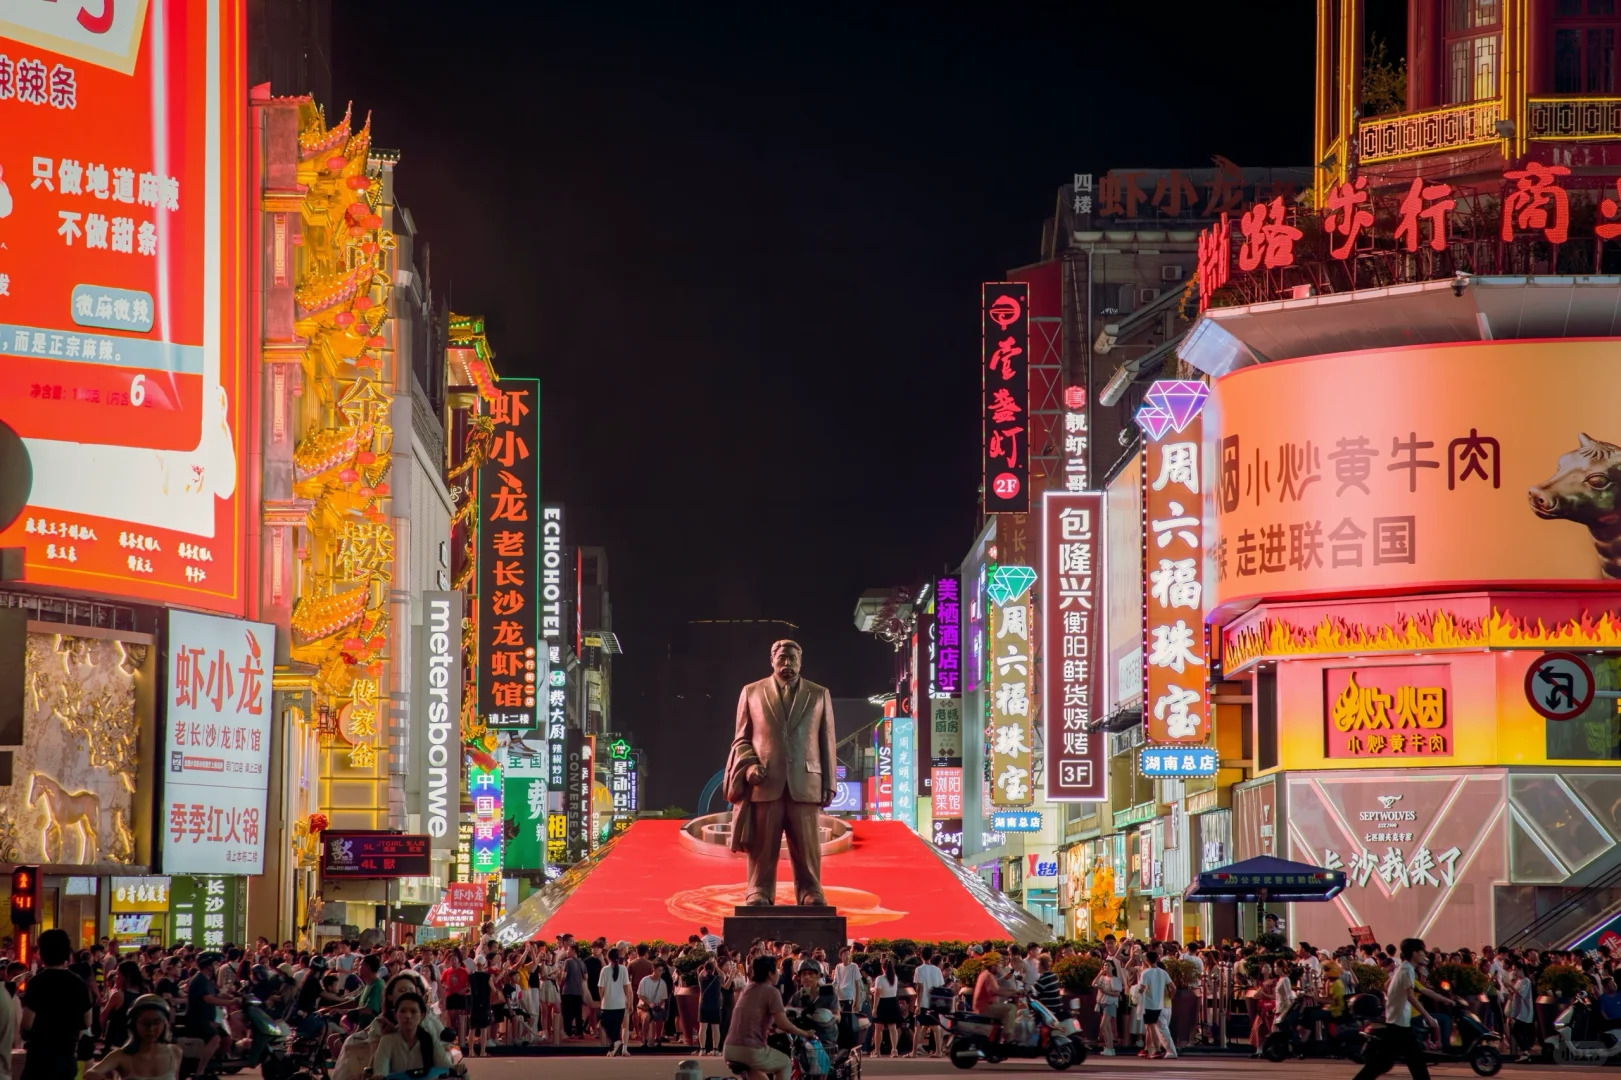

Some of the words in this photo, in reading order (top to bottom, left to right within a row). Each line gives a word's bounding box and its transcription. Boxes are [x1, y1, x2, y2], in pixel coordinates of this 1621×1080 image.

[31, 156, 180, 211] 只做地道麻辣
[1073, 173, 1093, 214] 四楼
[57, 210, 158, 256] 不做甜条
[988, 336, 1024, 469] 壹盏灯
[489, 389, 530, 522] 虾小龙
[995, 478, 1017, 493] 2F
[1058, 507, 1092, 610] 包隆兴
[1149, 441, 1205, 739] 周六福珠宝
[491, 530, 526, 708] 老长沙龙虾馆
[937, 578, 959, 670] 美栖酒店
[175, 628, 265, 716] 虾小龙
[995, 606, 1030, 801] 周六福珠宝
[1063, 611, 1089, 756] 衡阳鲜货烧烤
[427, 600, 453, 838] metersbonwe
[488, 713, 529, 725] 请上二楼
[549, 689, 566, 741] 费大厨
[1347, 733, 1444, 754] 小炒黄牛肉
[569, 752, 580, 829] CONVERSE
[1063, 766, 1088, 782] 3F
[1145, 755, 1215, 771] 湖南总店
[170, 803, 259, 846] 季季红火锅
[1359, 810, 1417, 821] SEPTWOLVES
[204, 880, 225, 952] 长沙眼镜
